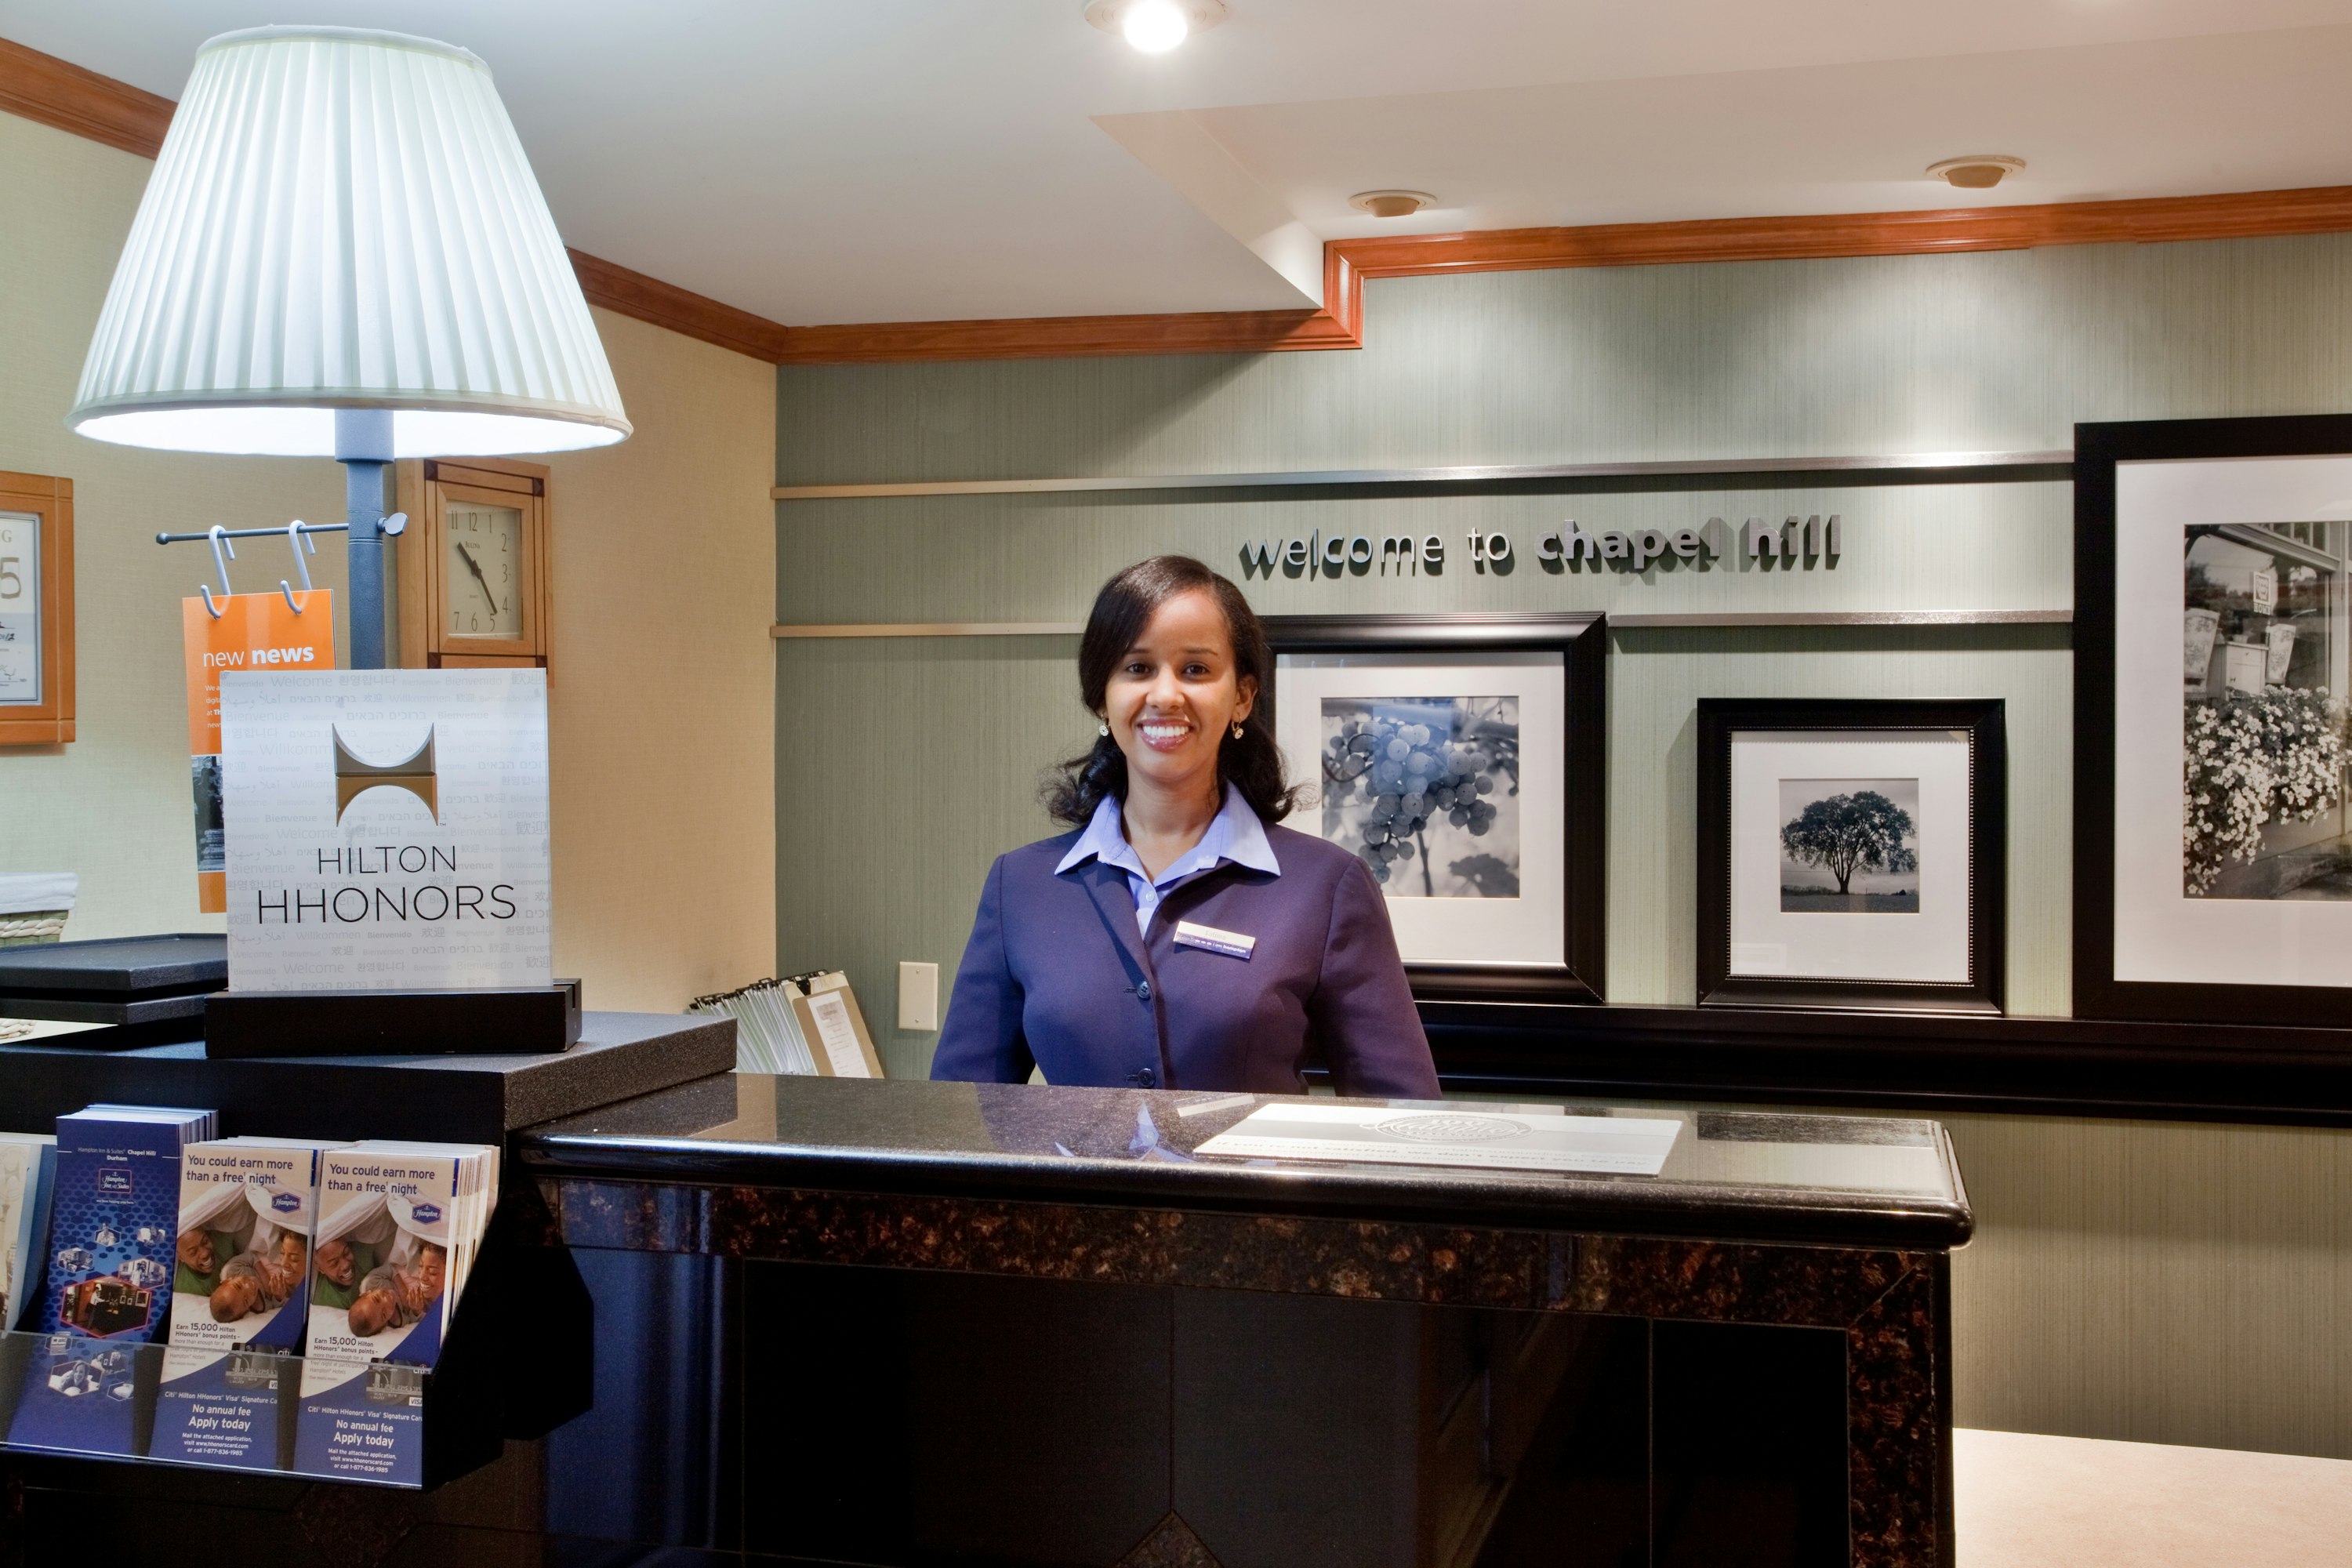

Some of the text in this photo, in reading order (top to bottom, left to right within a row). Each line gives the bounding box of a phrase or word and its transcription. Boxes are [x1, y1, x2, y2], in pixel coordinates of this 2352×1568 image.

[452, 510, 492, 533] 11 12 1
[502, 533, 506, 552] 2
[1245, 514, 1841, 569] welcome to chapel hill
[503, 564, 507, 583] 3
[503, 596, 508, 615] 4
[454, 612, 495, 632] 7 6 5
[202, 647, 314, 667] new news
[270, 676, 332, 687] Welcome
[339, 674, 395, 686] 환영합니다
[445, 677, 502, 686] Bienvenido
[389, 694, 450, 702] Willkommen
[226, 712, 290, 721] Bienvenue
[347, 711, 426, 720] ברוכים הבאים
[276, 828, 337, 839] Welcome
[451, 828, 508, 837] Bienvenido
[318, 845, 455, 874] HILTON
[232, 863, 295, 874] Bienvenue
[259, 884, 516, 924] HHONORS
[296, 931, 361, 940] Willkommen
[412, 946, 445, 954] הבאים
[284, 963, 345, 974] Welcome
[358, 961, 405, 972] 환영합니다
[457, 961, 514, 971] Bienvenido
[188, 1155, 293, 1170] You could earn more
[329, 1163, 435, 1179] You could earn more
[187, 1171, 209, 1181] than
[249, 1173, 276, 1185] night
[328, 1179, 353, 1190] than
[391, 1182, 417, 1196] night
[274, 1199, 299, 1207] Hampton
[414, 1210, 439, 1218] Hampton
[191, 1323, 218, 1331] 15,000
[328, 1337, 357, 1346] 15,000
[192, 1404, 251, 1416] No annual fee
[188, 1416, 251, 1432] Apply today
[336, 1419, 394, 1432] No annual fee
[333, 1432, 394, 1448] Apply today
[342, 1457, 394, 1466] www.hhonorscard.com
